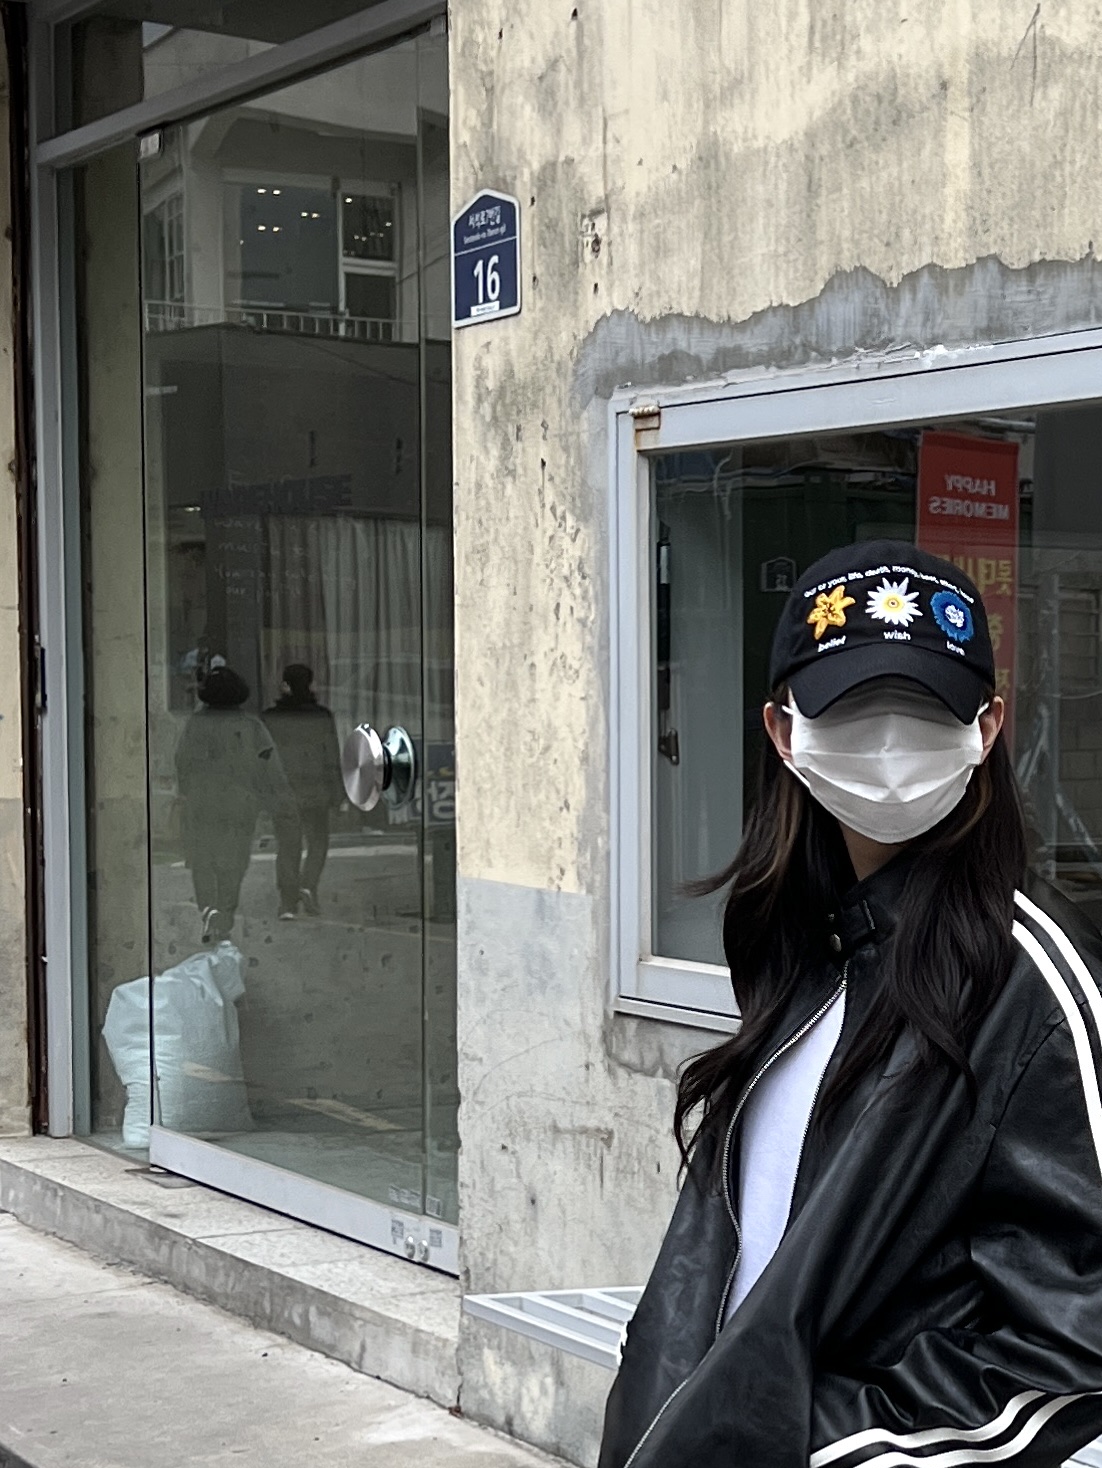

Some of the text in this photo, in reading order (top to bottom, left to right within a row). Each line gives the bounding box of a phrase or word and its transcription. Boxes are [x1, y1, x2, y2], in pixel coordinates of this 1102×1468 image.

[473, 254, 501, 305] 16
[817, 635, 847, 653] belief
[883, 630, 911, 641] wish
